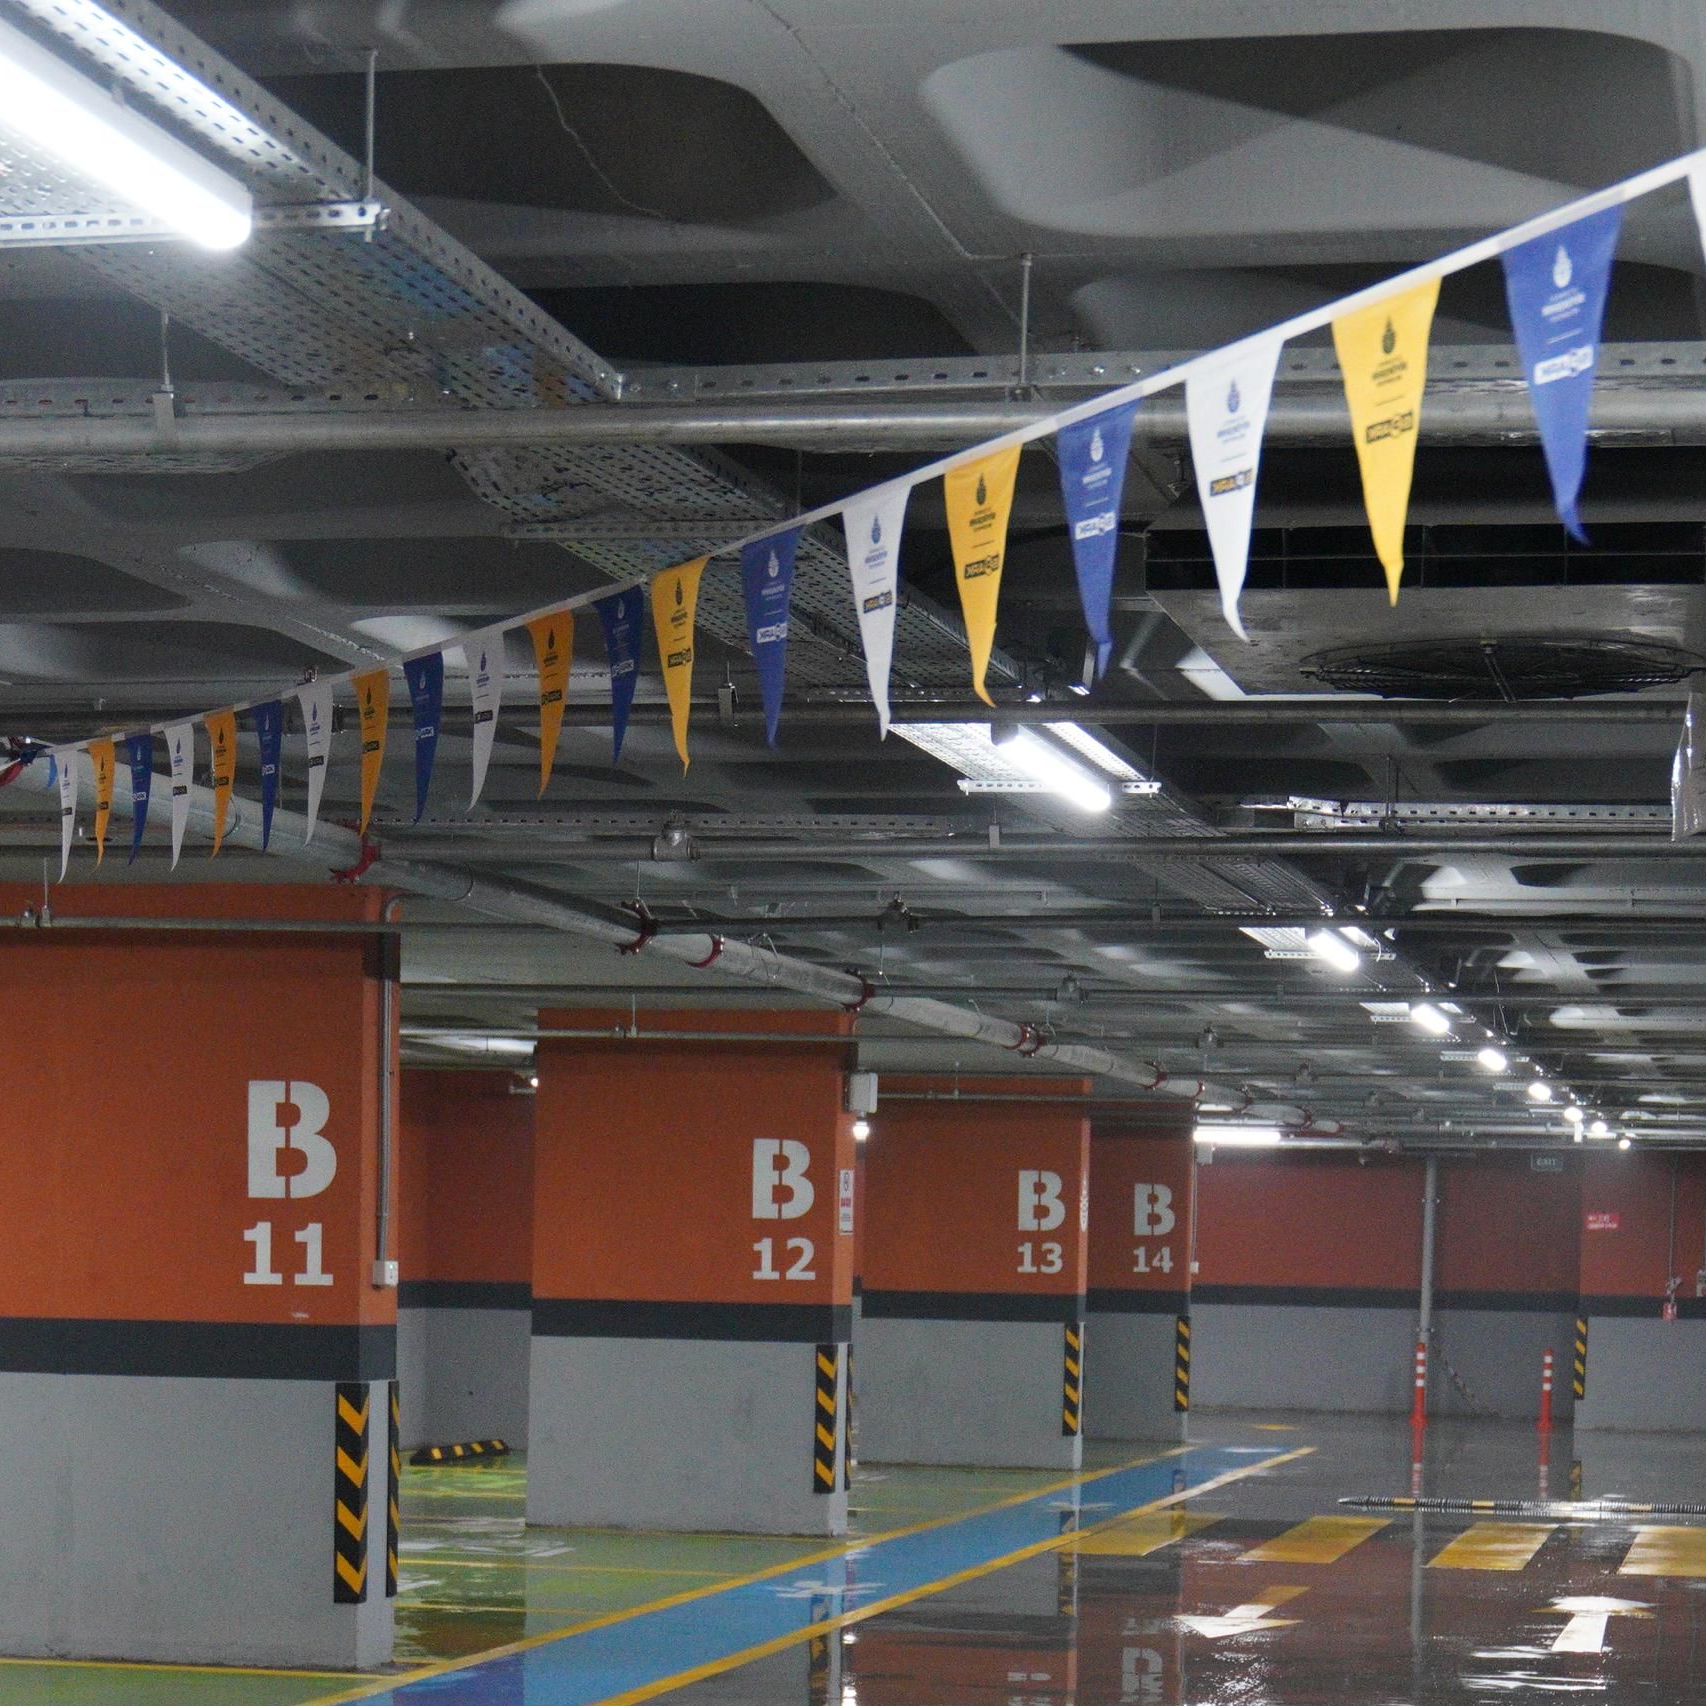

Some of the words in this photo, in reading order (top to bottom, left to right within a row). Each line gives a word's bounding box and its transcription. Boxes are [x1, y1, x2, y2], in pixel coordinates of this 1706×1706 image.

[248, 1081, 336, 1198] B
[1536, 1158, 1557, 1166] EXIT
[752, 1139, 814, 1219] B
[1018, 1170, 1065, 1230] B
[1134, 1184, 1175, 1235] B
[244, 1222, 333, 1285] 11
[753, 1237, 816, 1280] 12
[1018, 1242, 1063, 1273] 13
[1134, 1247, 1173, 1273] 14
